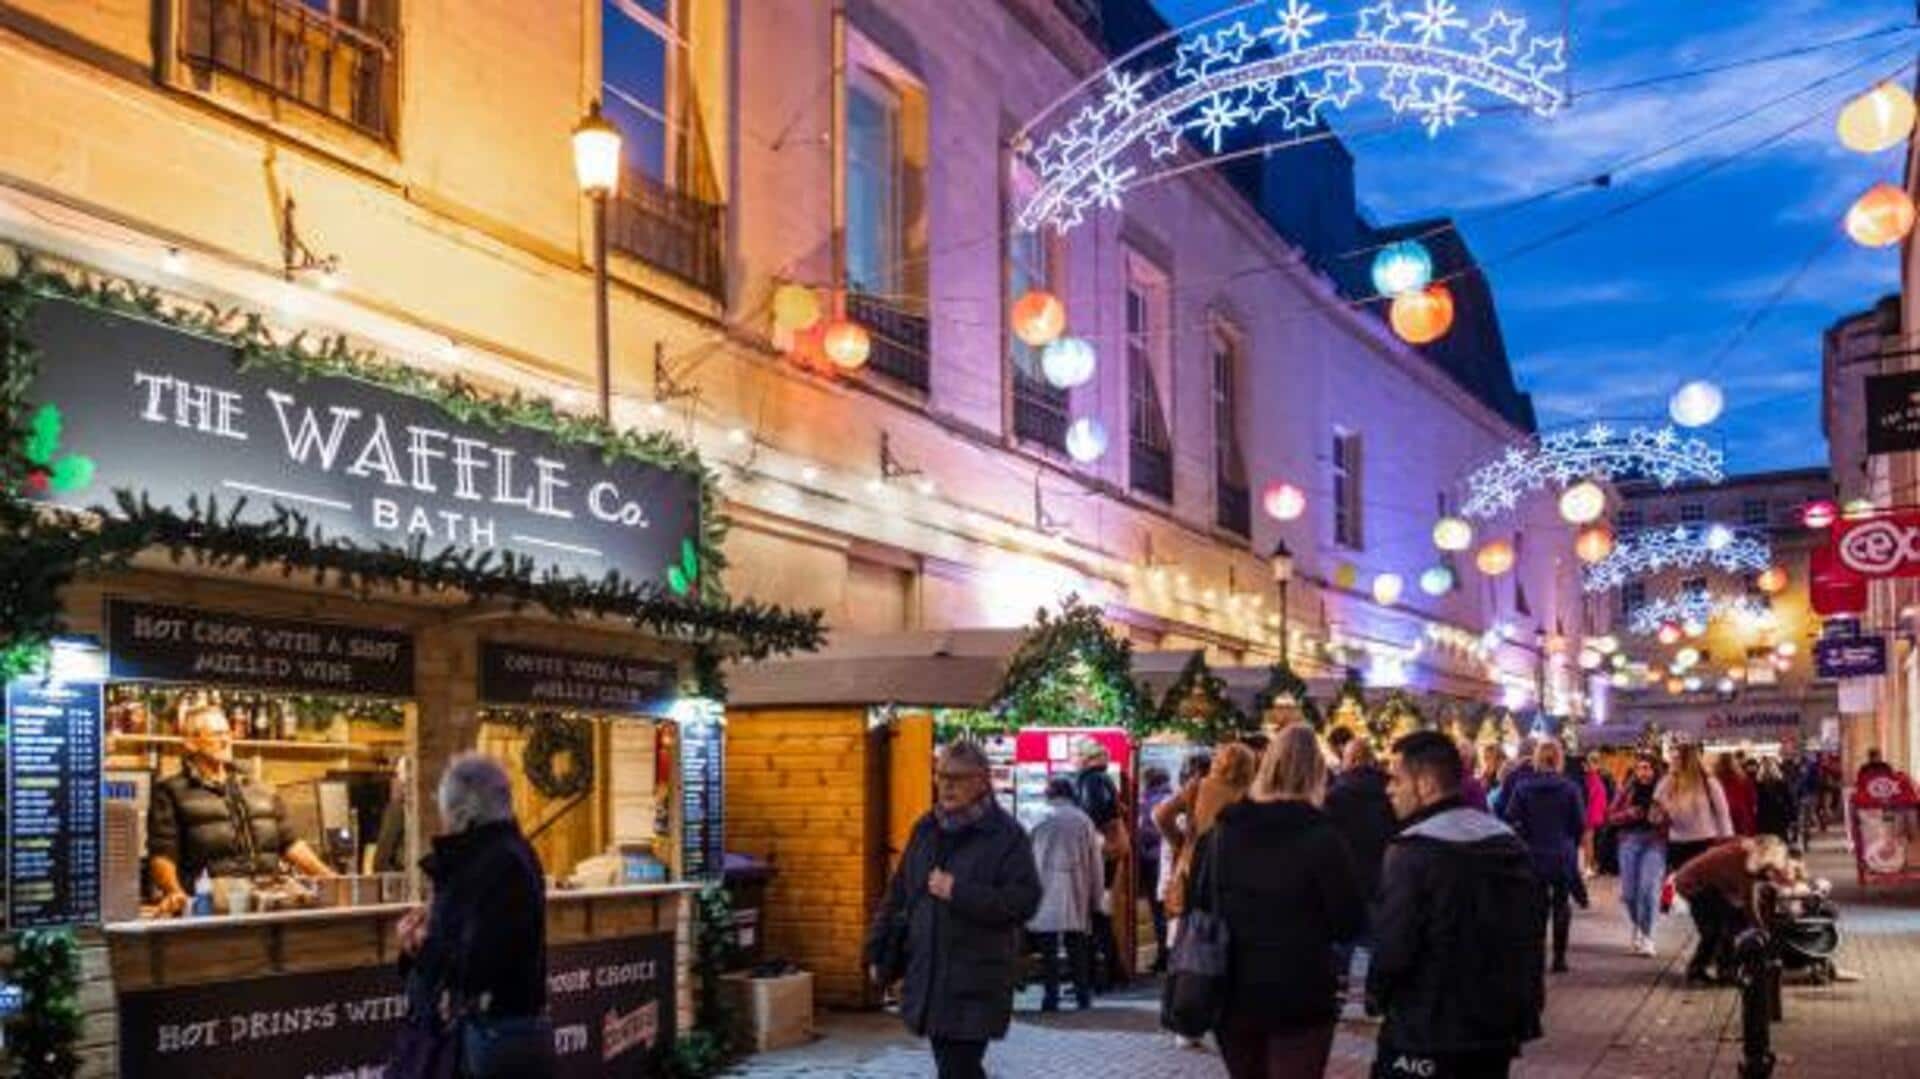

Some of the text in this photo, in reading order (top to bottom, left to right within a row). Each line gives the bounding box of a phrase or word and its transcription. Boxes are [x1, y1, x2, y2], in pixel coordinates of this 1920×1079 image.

[134, 371, 649, 528] THE WAFFLE Co.
[373, 498, 494, 546] BATH
[133, 614, 187, 641] HOT
[192, 621, 253, 647] CHOC
[263, 629, 321, 654] WITH
[326, 635, 343, 654] A
[195, 652, 353, 684] MULLED WINE
[157, 1018, 220, 1052] HOT
[230, 1003, 338, 1041] DRINKS
[1392, 1055, 1436, 1077] AIG
